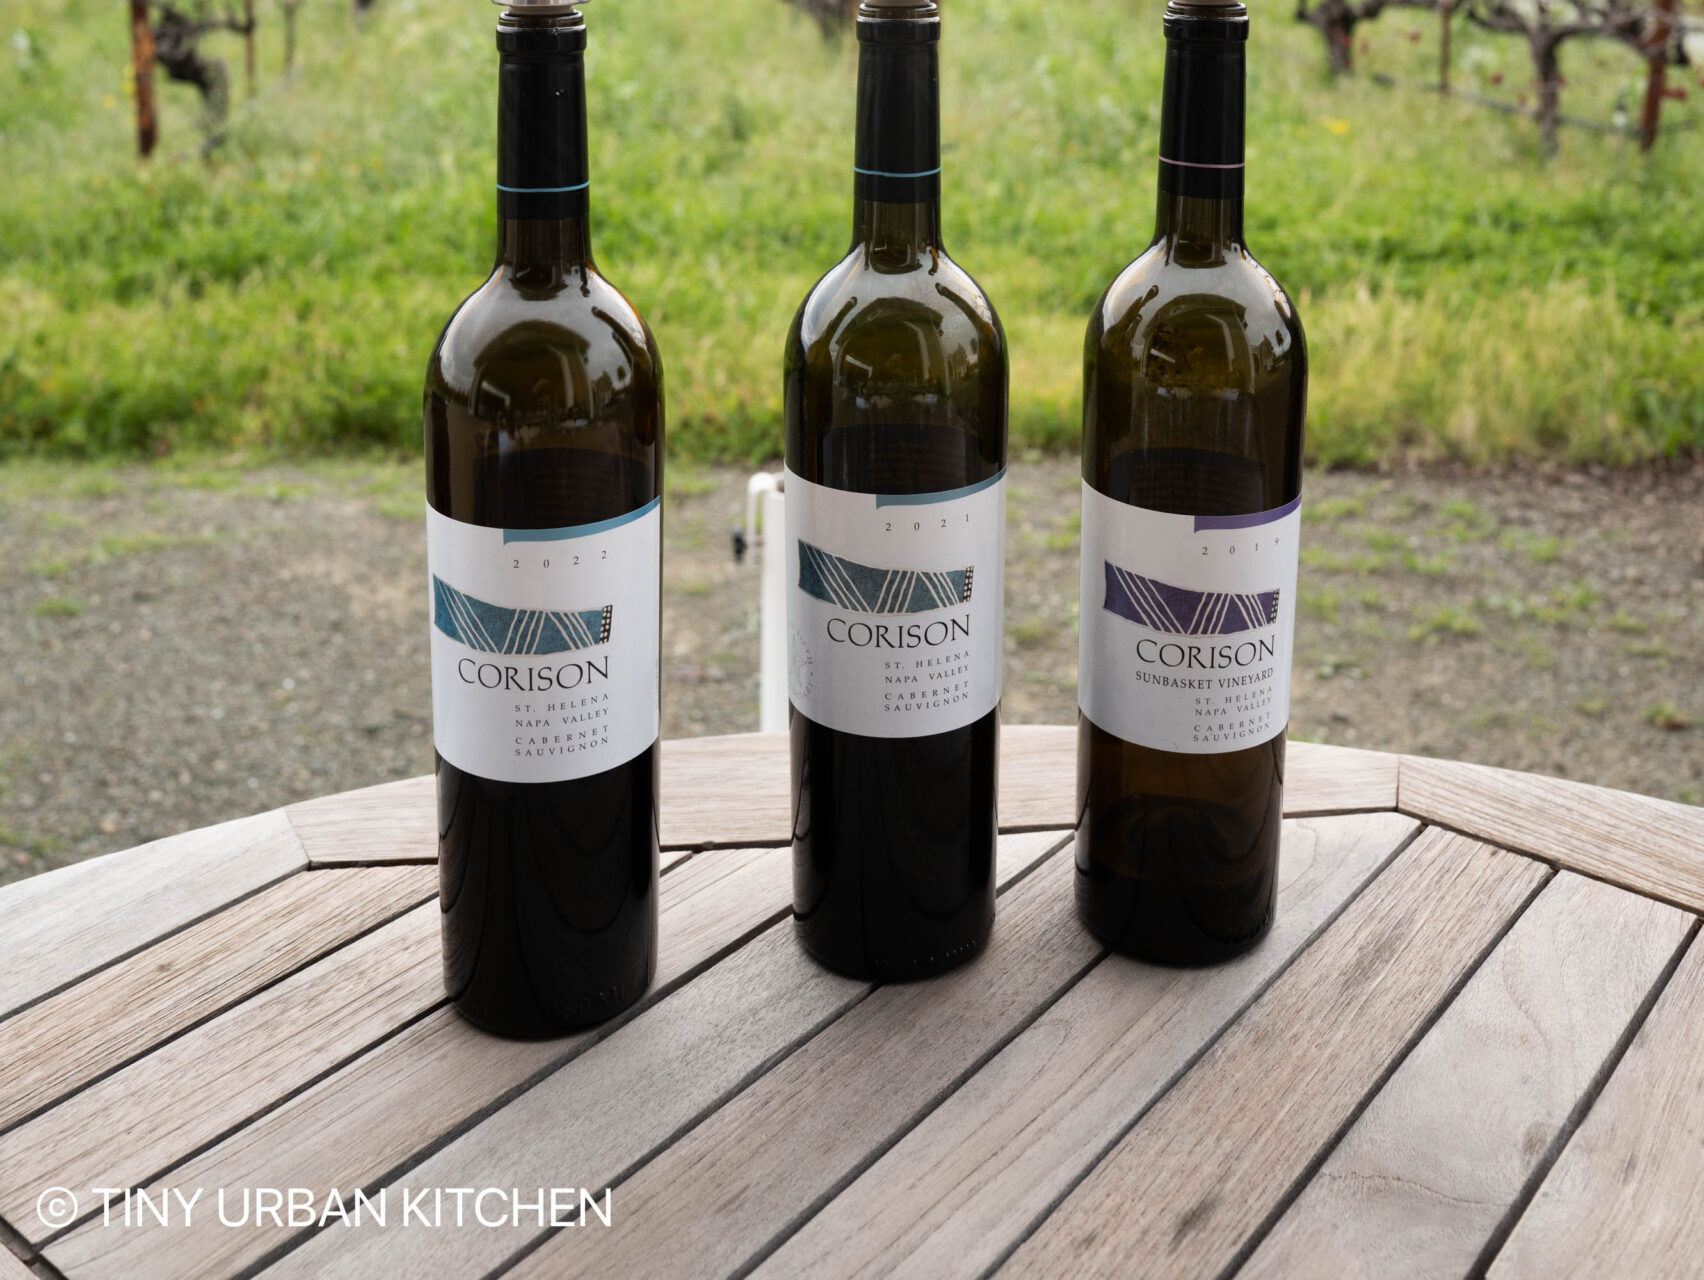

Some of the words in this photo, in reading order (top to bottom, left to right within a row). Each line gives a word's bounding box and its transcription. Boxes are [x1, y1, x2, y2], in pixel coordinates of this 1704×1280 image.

[885, 514, 969, 531] 2021
[1202, 537, 1279, 555] 2019
[513, 550, 607, 569] 2022
[827, 614, 970, 648] CORISON
[885, 661, 904, 669] ST.
[916, 650, 969, 668] HELENA
[1136, 635, 1275, 669] CORISON
[458, 656, 609, 692] CORISON
[885, 675, 918, 684] NAPA
[929, 664, 969, 681] VALLEY
[1136, 671, 1213, 689] SUNBASKET
[1219, 667, 1274, 688] VINEYARD
[885, 681, 969, 700] CABERNET
[1195, 697, 1215, 706] ST.
[1225, 686, 1272, 704] HELENA
[514, 704, 536, 713] ST.
[547, 693, 609, 712] HELENA
[885, 692, 968, 711] SAUVIGNON
[1195, 708, 1227, 716] NAPA
[1237, 696, 1272, 713] VALLEY
[515, 719, 550, 728] NAPA
[562, 708, 609, 725] VALLEY
[1194, 712, 1271, 732] CABERNET
[515, 725, 609, 745] CABERNET
[1193, 723, 1270, 742] SAUVIGNON
[515, 736, 609, 756] SAUVIGNON
